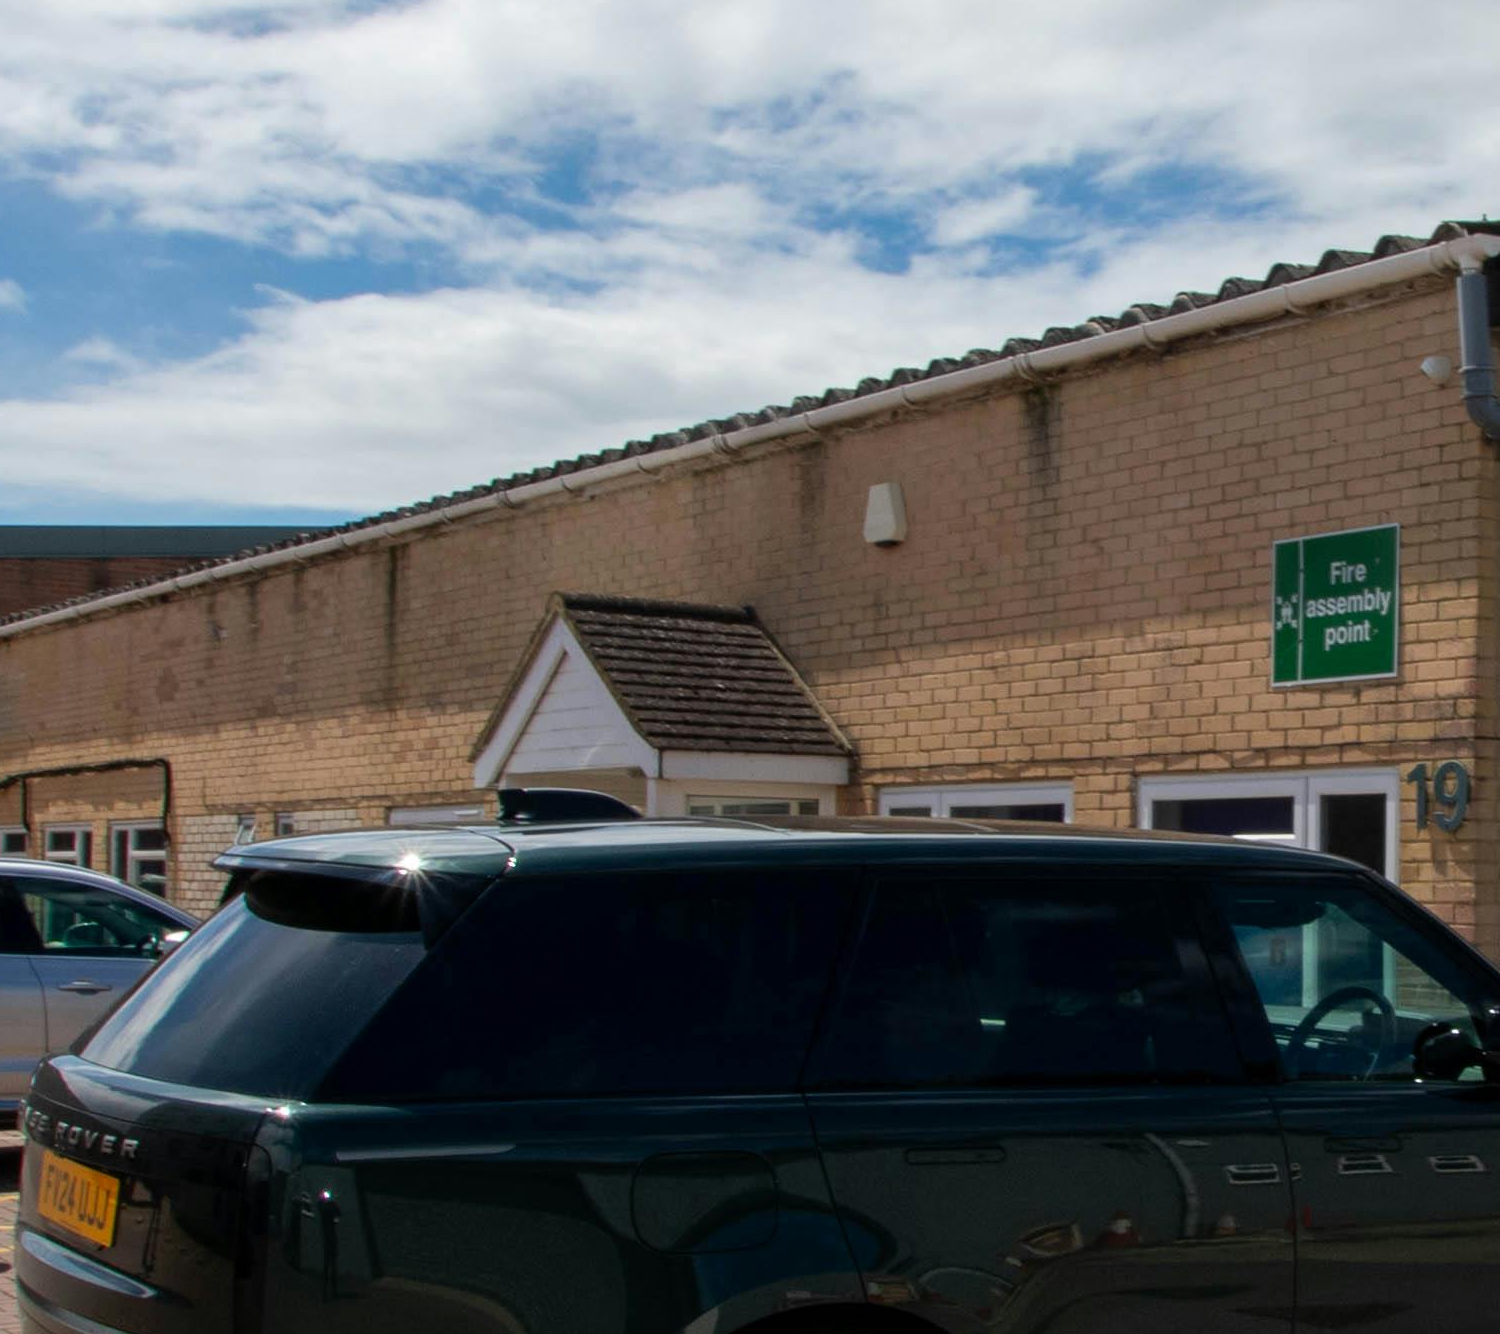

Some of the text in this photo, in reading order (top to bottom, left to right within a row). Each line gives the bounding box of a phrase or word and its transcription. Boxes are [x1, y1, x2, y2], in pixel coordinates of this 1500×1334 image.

[1330, 562, 1366, 585] Fire
[1306, 588, 1391, 617] assembly
[1324, 620, 1371, 650] point
[1407, 761, 1468, 831] 19
[55, 1122, 139, 1158] ROVER
